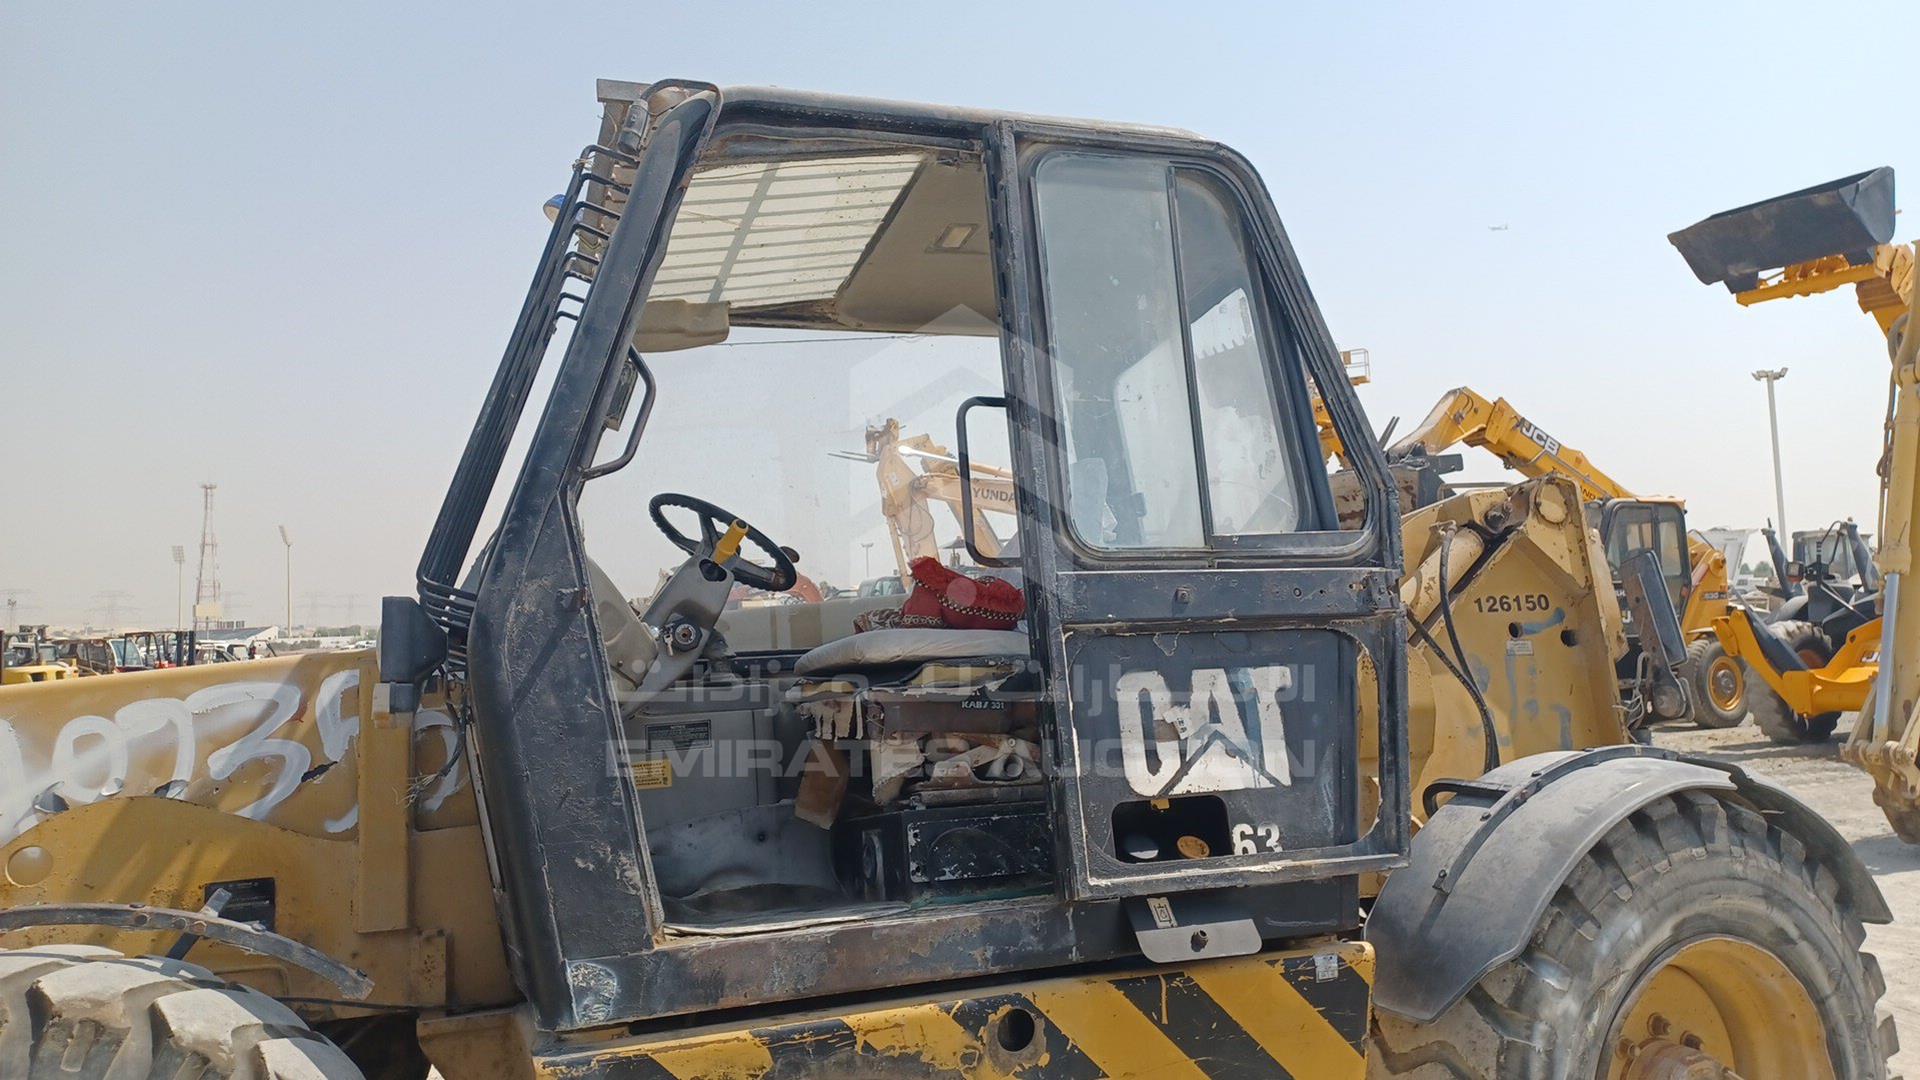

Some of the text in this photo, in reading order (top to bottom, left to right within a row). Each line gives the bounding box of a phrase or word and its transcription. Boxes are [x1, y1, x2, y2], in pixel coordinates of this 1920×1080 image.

[1520, 420, 1560, 457] JCB
[973, 487, 1014, 502] YUNDA
[1474, 594, 1550, 613] 126150
[1116, 666, 1293, 797] CAT
